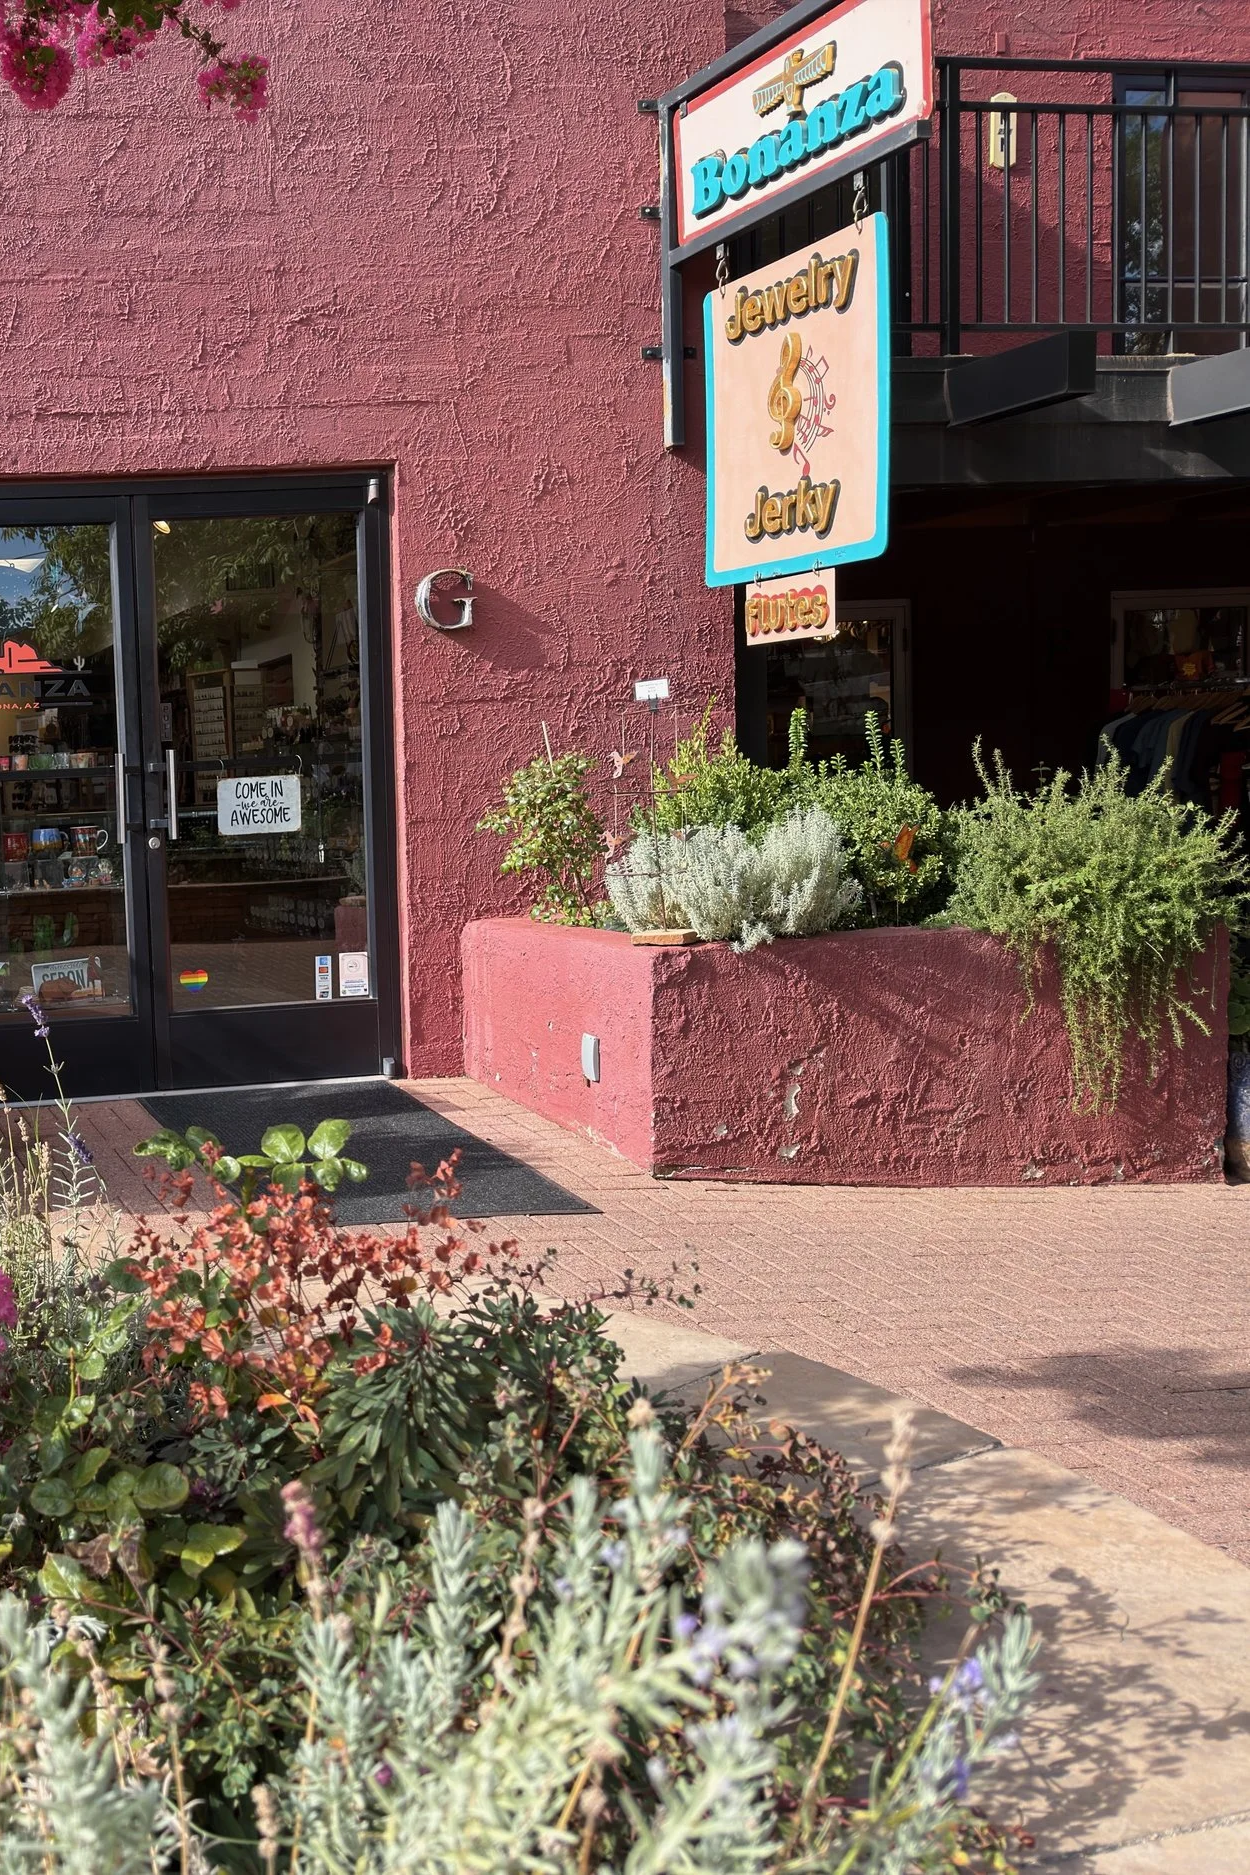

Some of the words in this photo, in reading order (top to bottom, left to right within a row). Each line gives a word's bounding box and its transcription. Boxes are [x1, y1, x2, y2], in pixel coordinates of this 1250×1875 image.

[690, 64, 904, 218] Bonanza
[725, 252, 857, 344] Jewelry
[745, 478, 839, 540] Jerky
[414, 568, 478, 631] G
[24, 702, 41, 710] AZ
[230, 807, 291, 827] AWESOME
[235, 780, 267, 799] COME
[270, 779, 284, 797] IN
